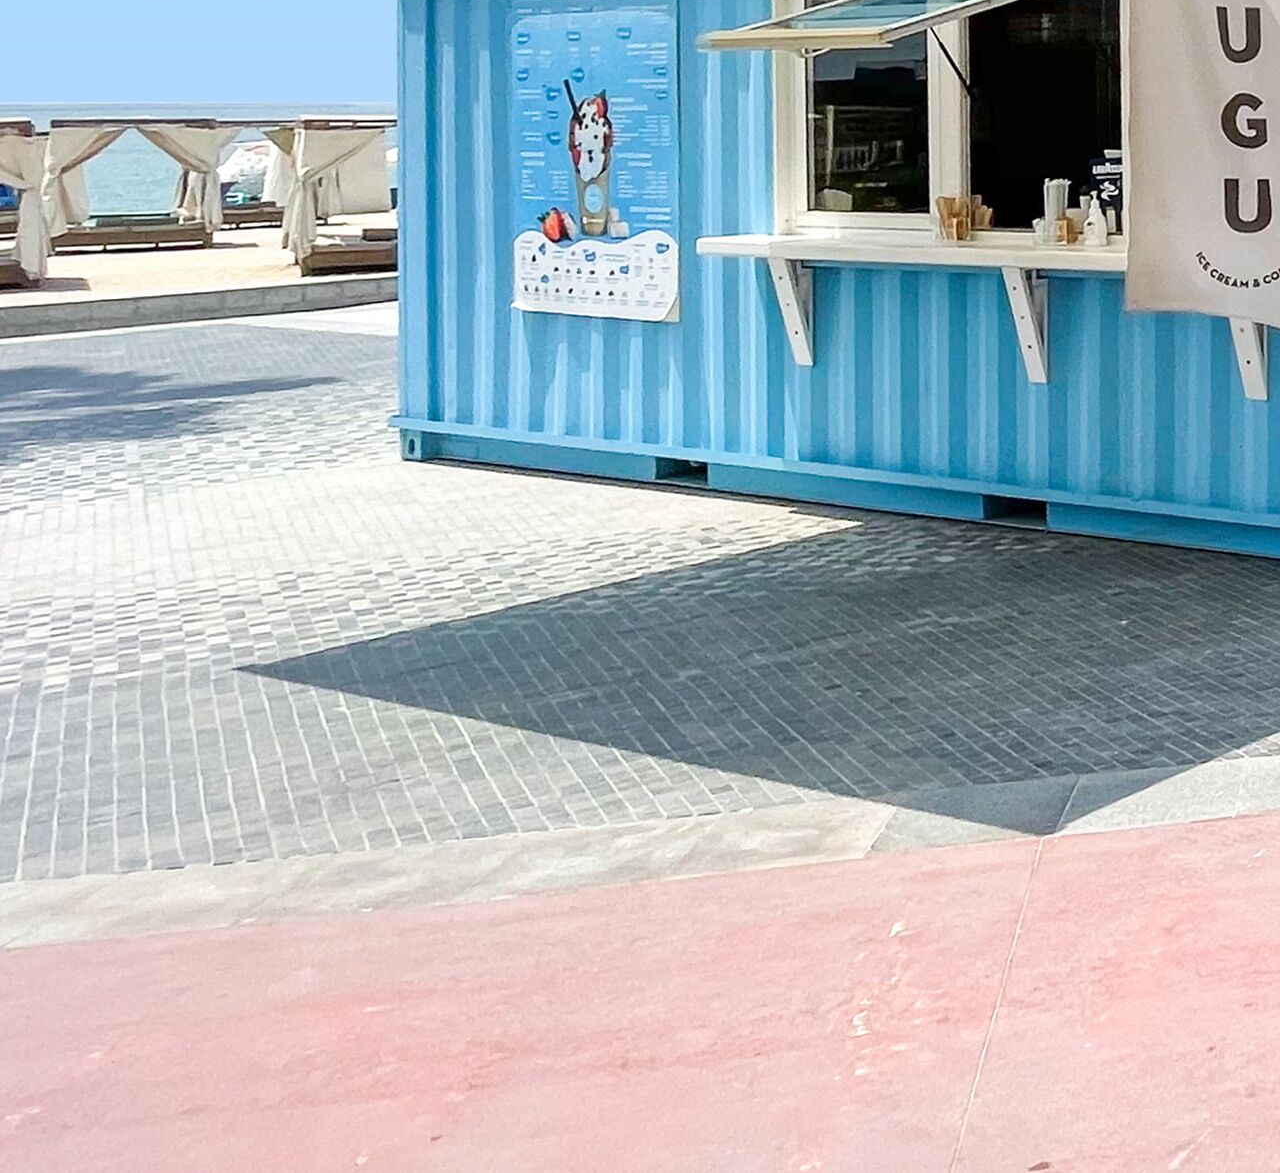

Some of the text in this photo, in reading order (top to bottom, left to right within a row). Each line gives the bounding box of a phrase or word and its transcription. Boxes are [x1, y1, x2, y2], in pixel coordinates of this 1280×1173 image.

[1195, 251, 1211, 271] ICE
[1210, 268, 1249, 288] CREAM
[1253, 278, 1260, 287] &
